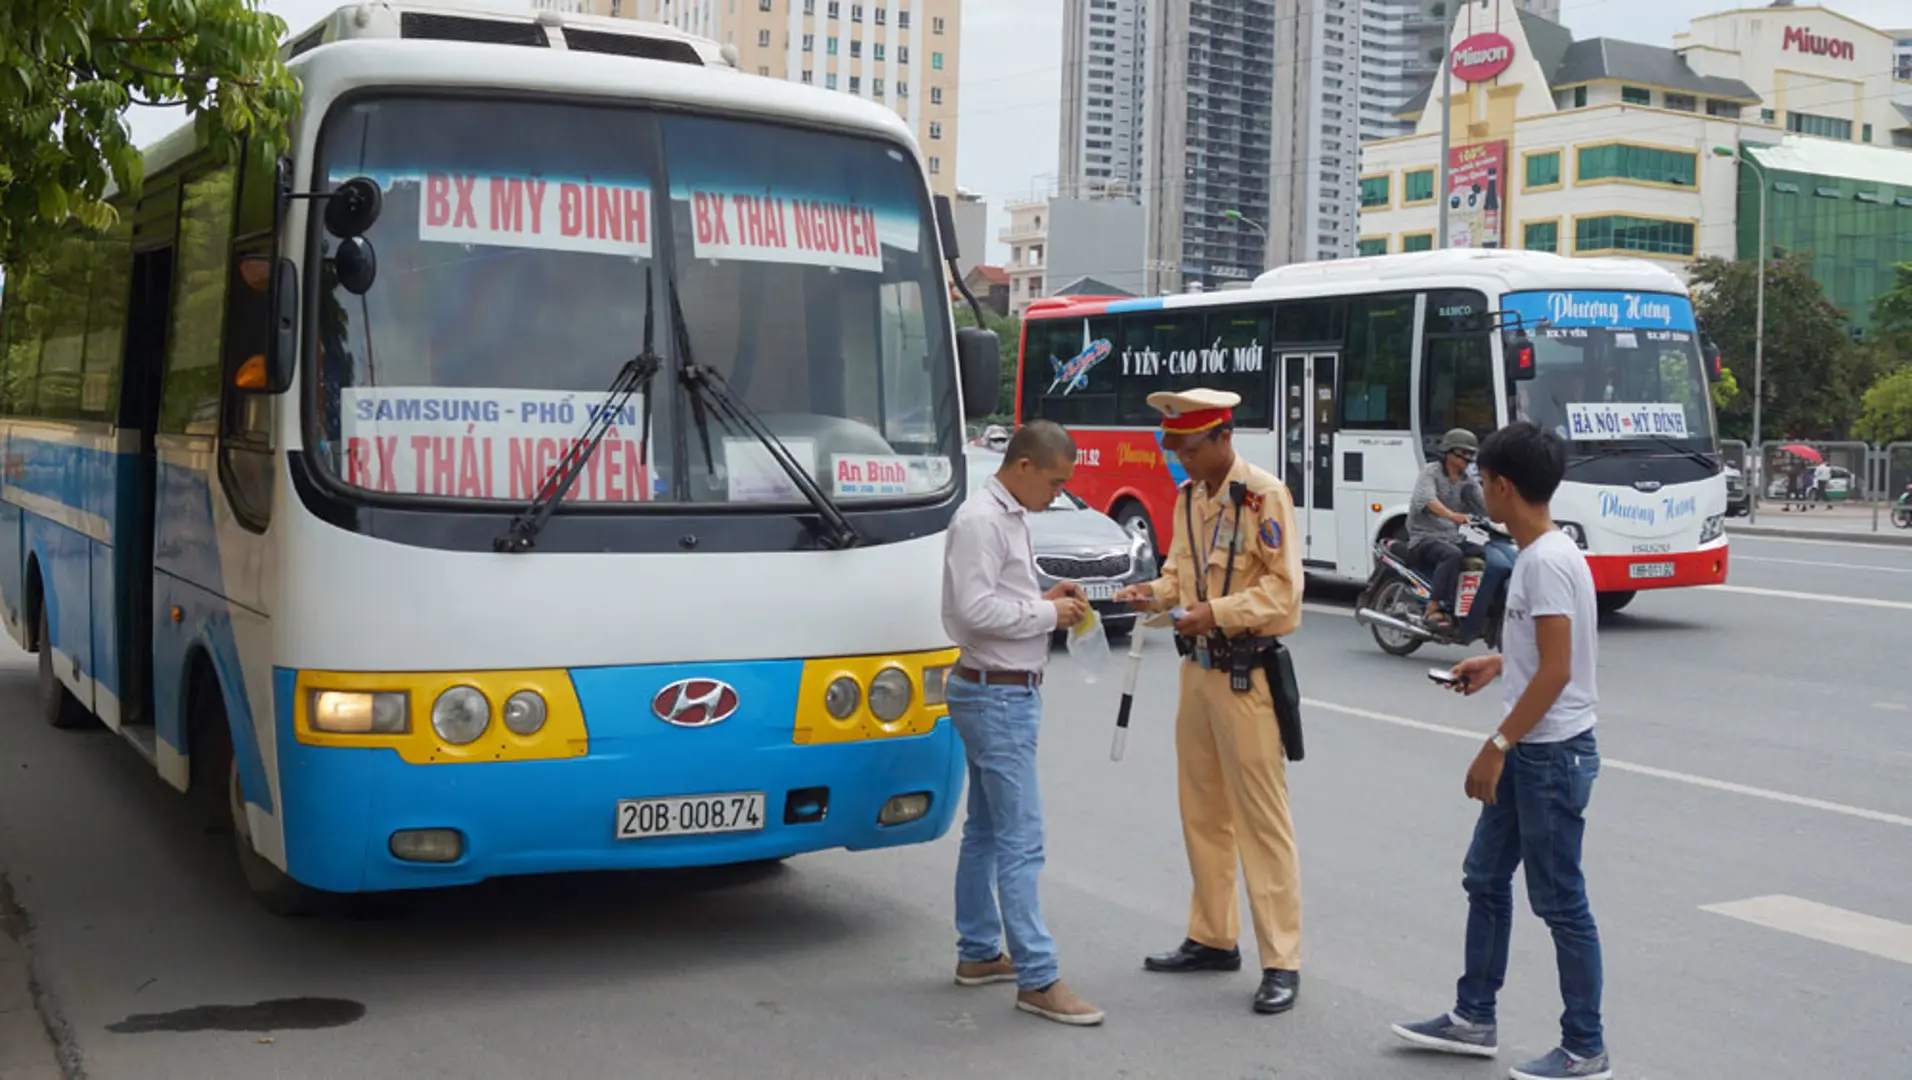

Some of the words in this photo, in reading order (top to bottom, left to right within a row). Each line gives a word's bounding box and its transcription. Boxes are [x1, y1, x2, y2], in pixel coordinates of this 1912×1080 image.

[1452, 46, 1508, 69] Miwon
[1782, 25, 1854, 61] Miwon
[426, 172, 478, 229] BX
[490, 169, 547, 234] MỸ
[558, 174, 648, 243] ĐÌNH
[692, 191, 729, 245] BX
[733, 186, 787, 248] THÁI
[792, 195, 879, 257] NGUYÊN
[1169, 350, 1197, 375] CAO
[1200, 336, 1228, 373] TỐC
[1233, 338, 1264, 373] MỚI
[355, 398, 500, 422] SAMSUNG
[1572, 406, 1594, 433] HÀ
[1595, 406, 1621, 438] NỘI
[347, 435, 398, 493] BX
[410, 423, 493, 500] THÁI
[837, 460, 862, 482] An
[622, 798, 760, 834] 20B-008.74
